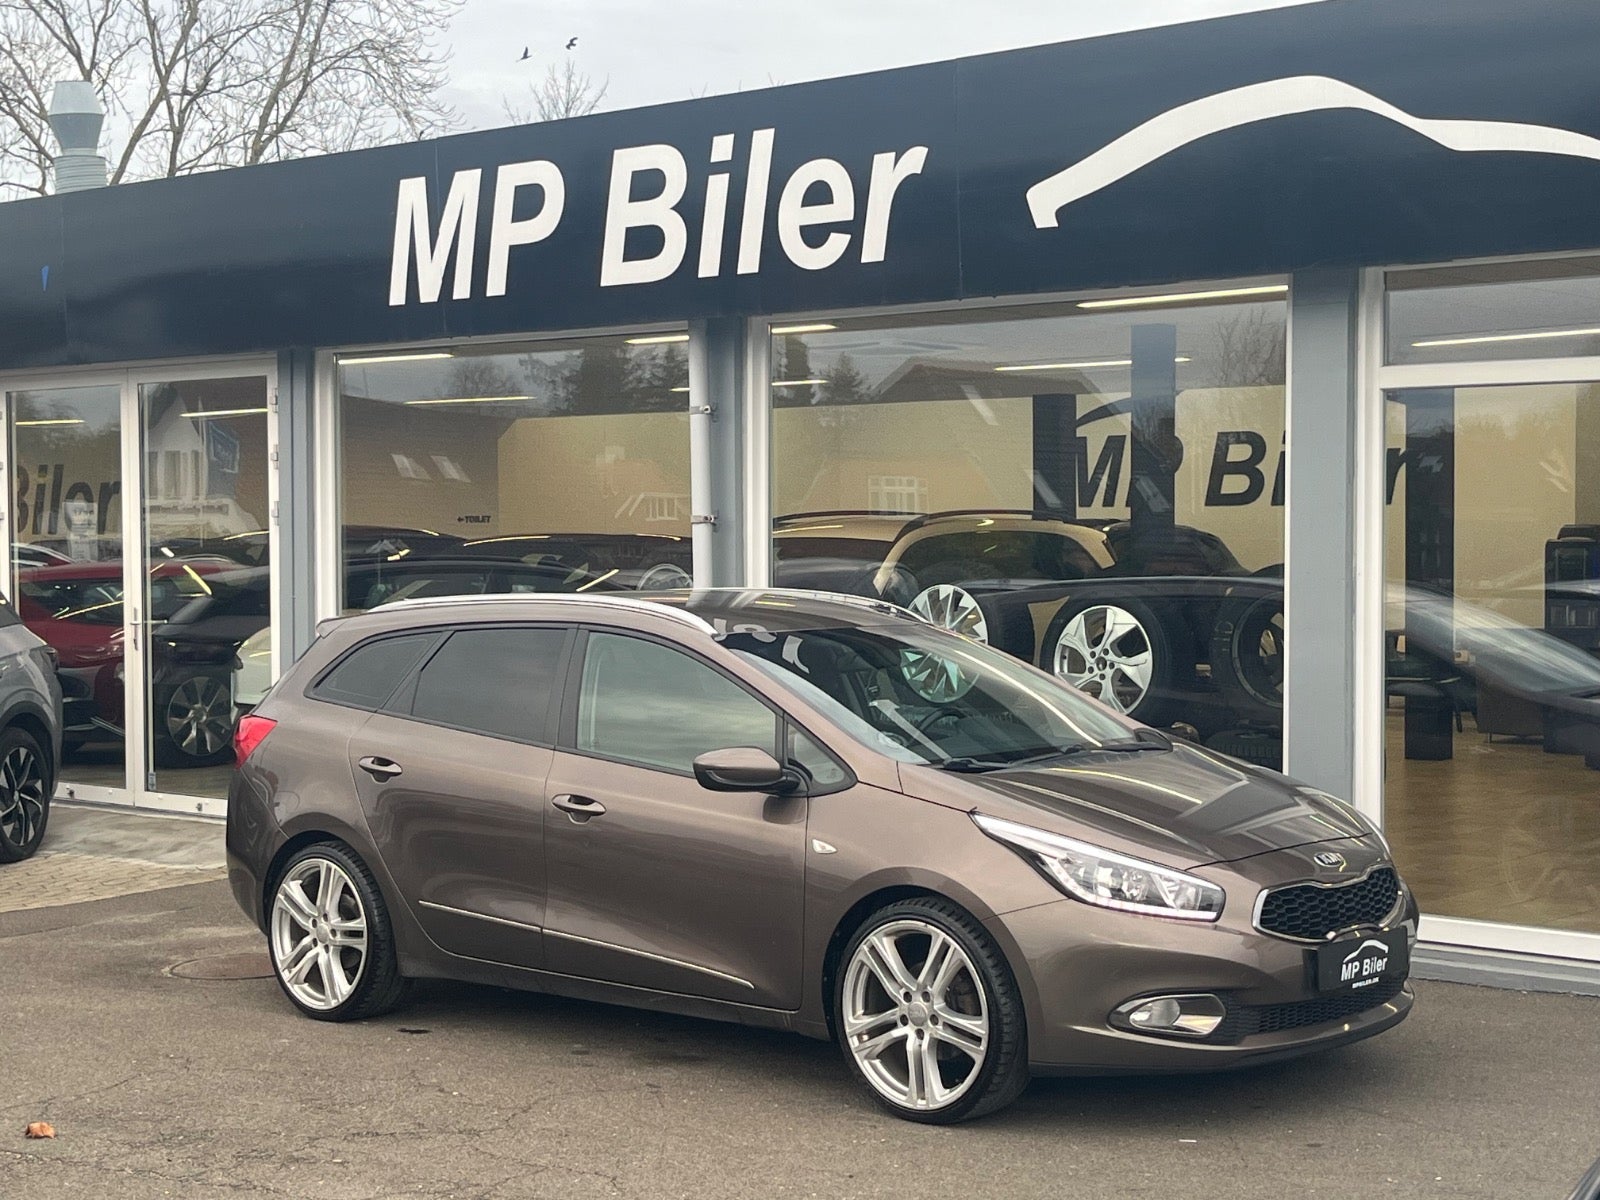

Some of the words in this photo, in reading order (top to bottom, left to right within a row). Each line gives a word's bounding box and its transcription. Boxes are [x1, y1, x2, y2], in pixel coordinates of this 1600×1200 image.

[389, 159, 565, 306] MP
[600, 128, 928, 288] Biler
[464, 515, 491, 524] TOILET
[1341, 961, 1360, 981] MP
[1362, 956, 1388, 976] Biler
